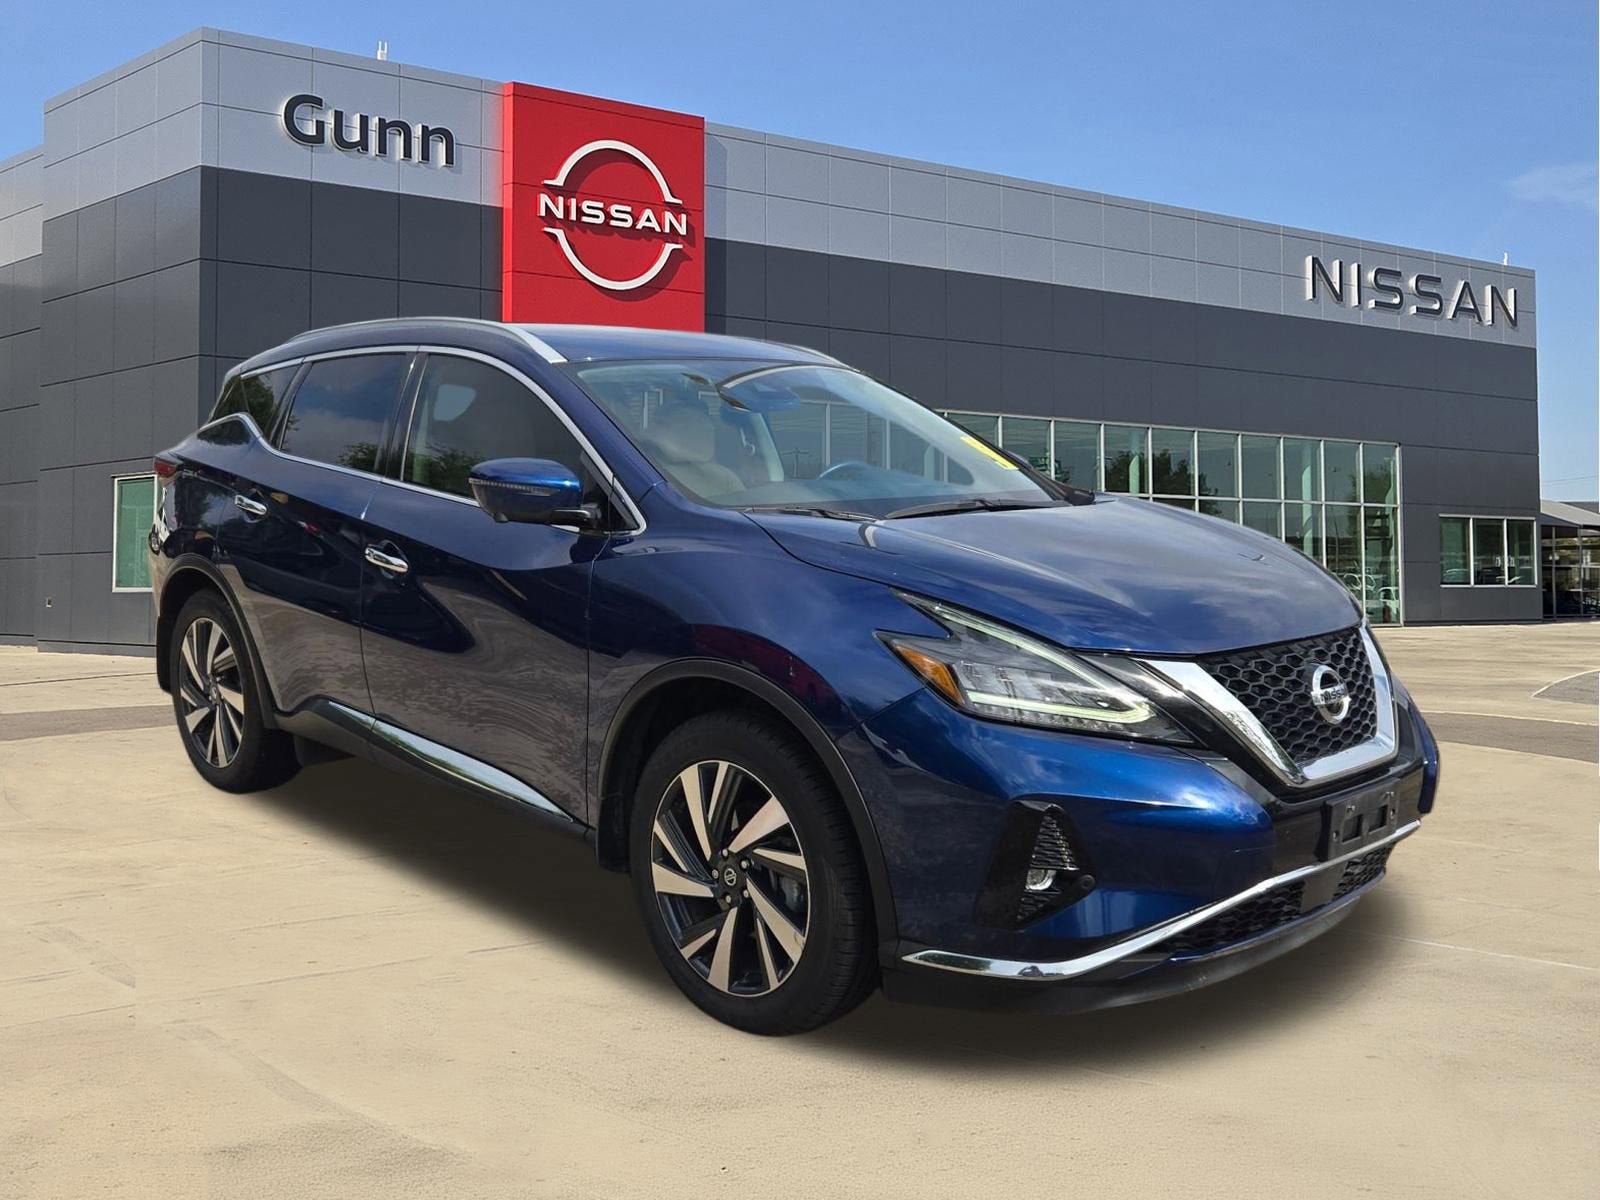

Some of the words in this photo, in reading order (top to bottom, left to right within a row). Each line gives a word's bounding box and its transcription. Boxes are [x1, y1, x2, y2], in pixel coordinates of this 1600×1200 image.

[282, 93, 455, 167] Gunn
[538, 193, 688, 236] NISSAN
[1306, 255, 1518, 328] NISSAN
